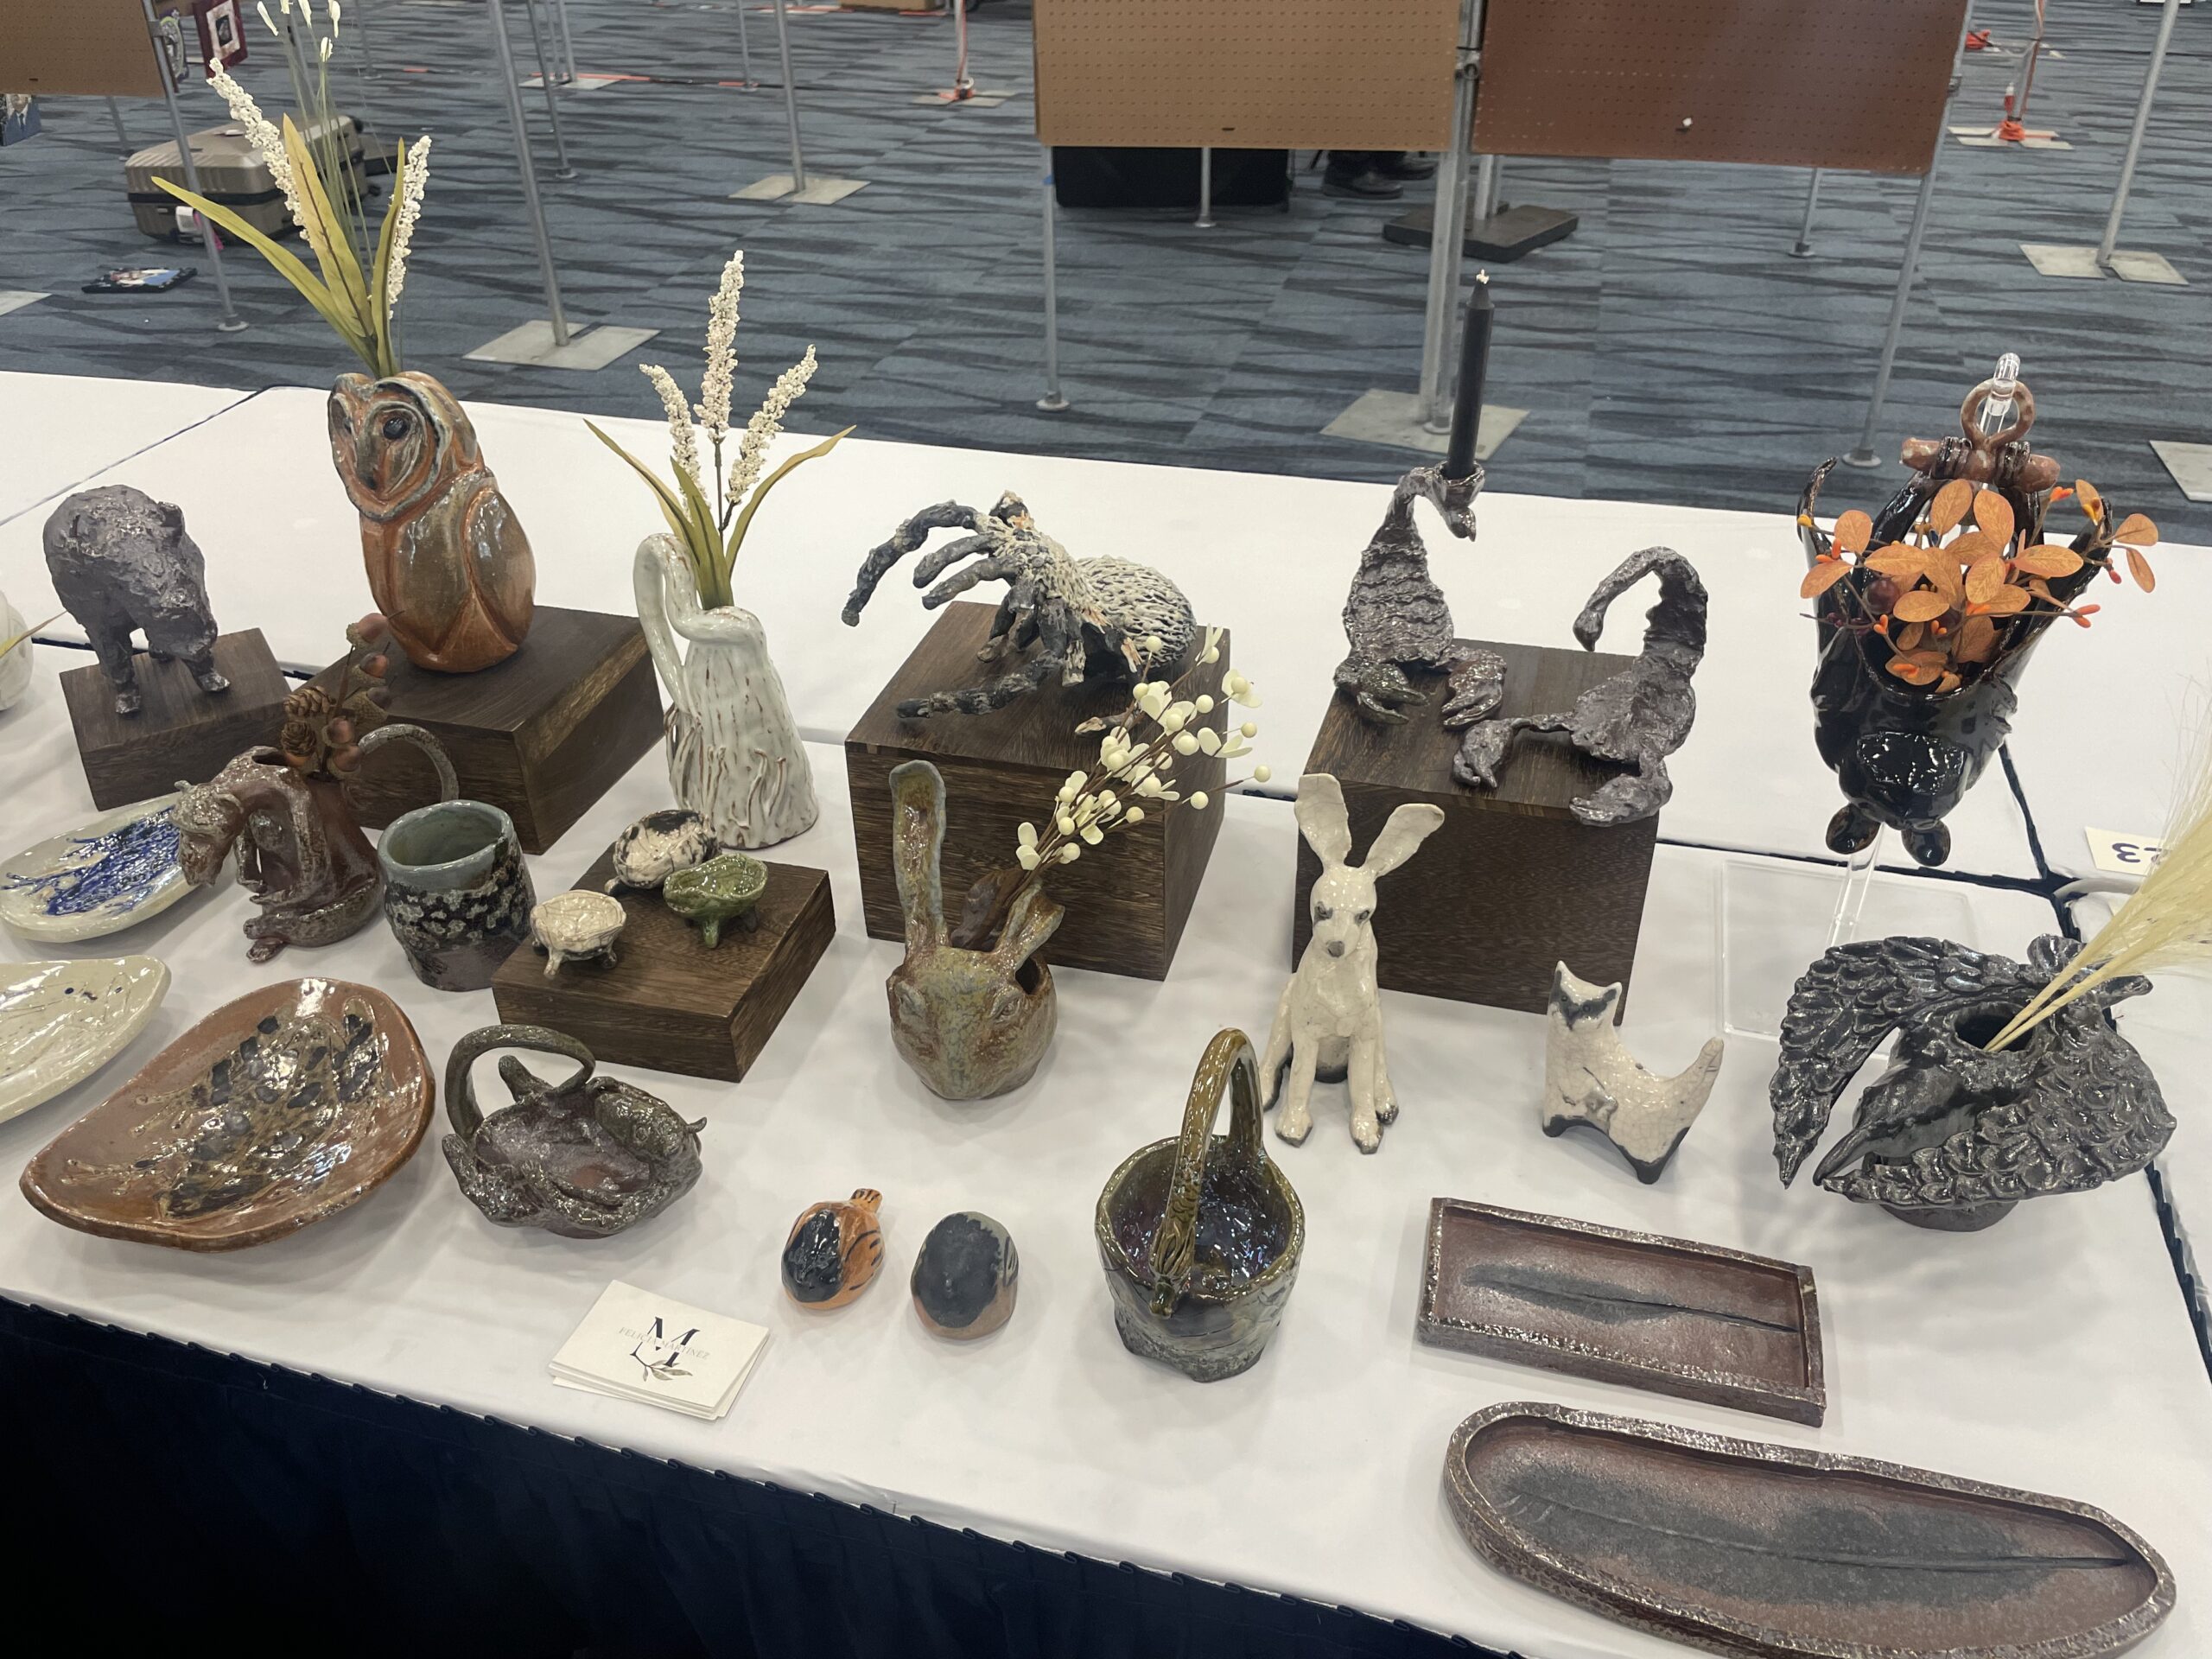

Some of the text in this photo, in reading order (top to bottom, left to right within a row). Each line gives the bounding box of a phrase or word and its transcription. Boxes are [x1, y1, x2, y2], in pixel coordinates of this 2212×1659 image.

[619, 1326, 710, 1360] FELICIA MARTINEZ
[630, 1317, 700, 1367] M
